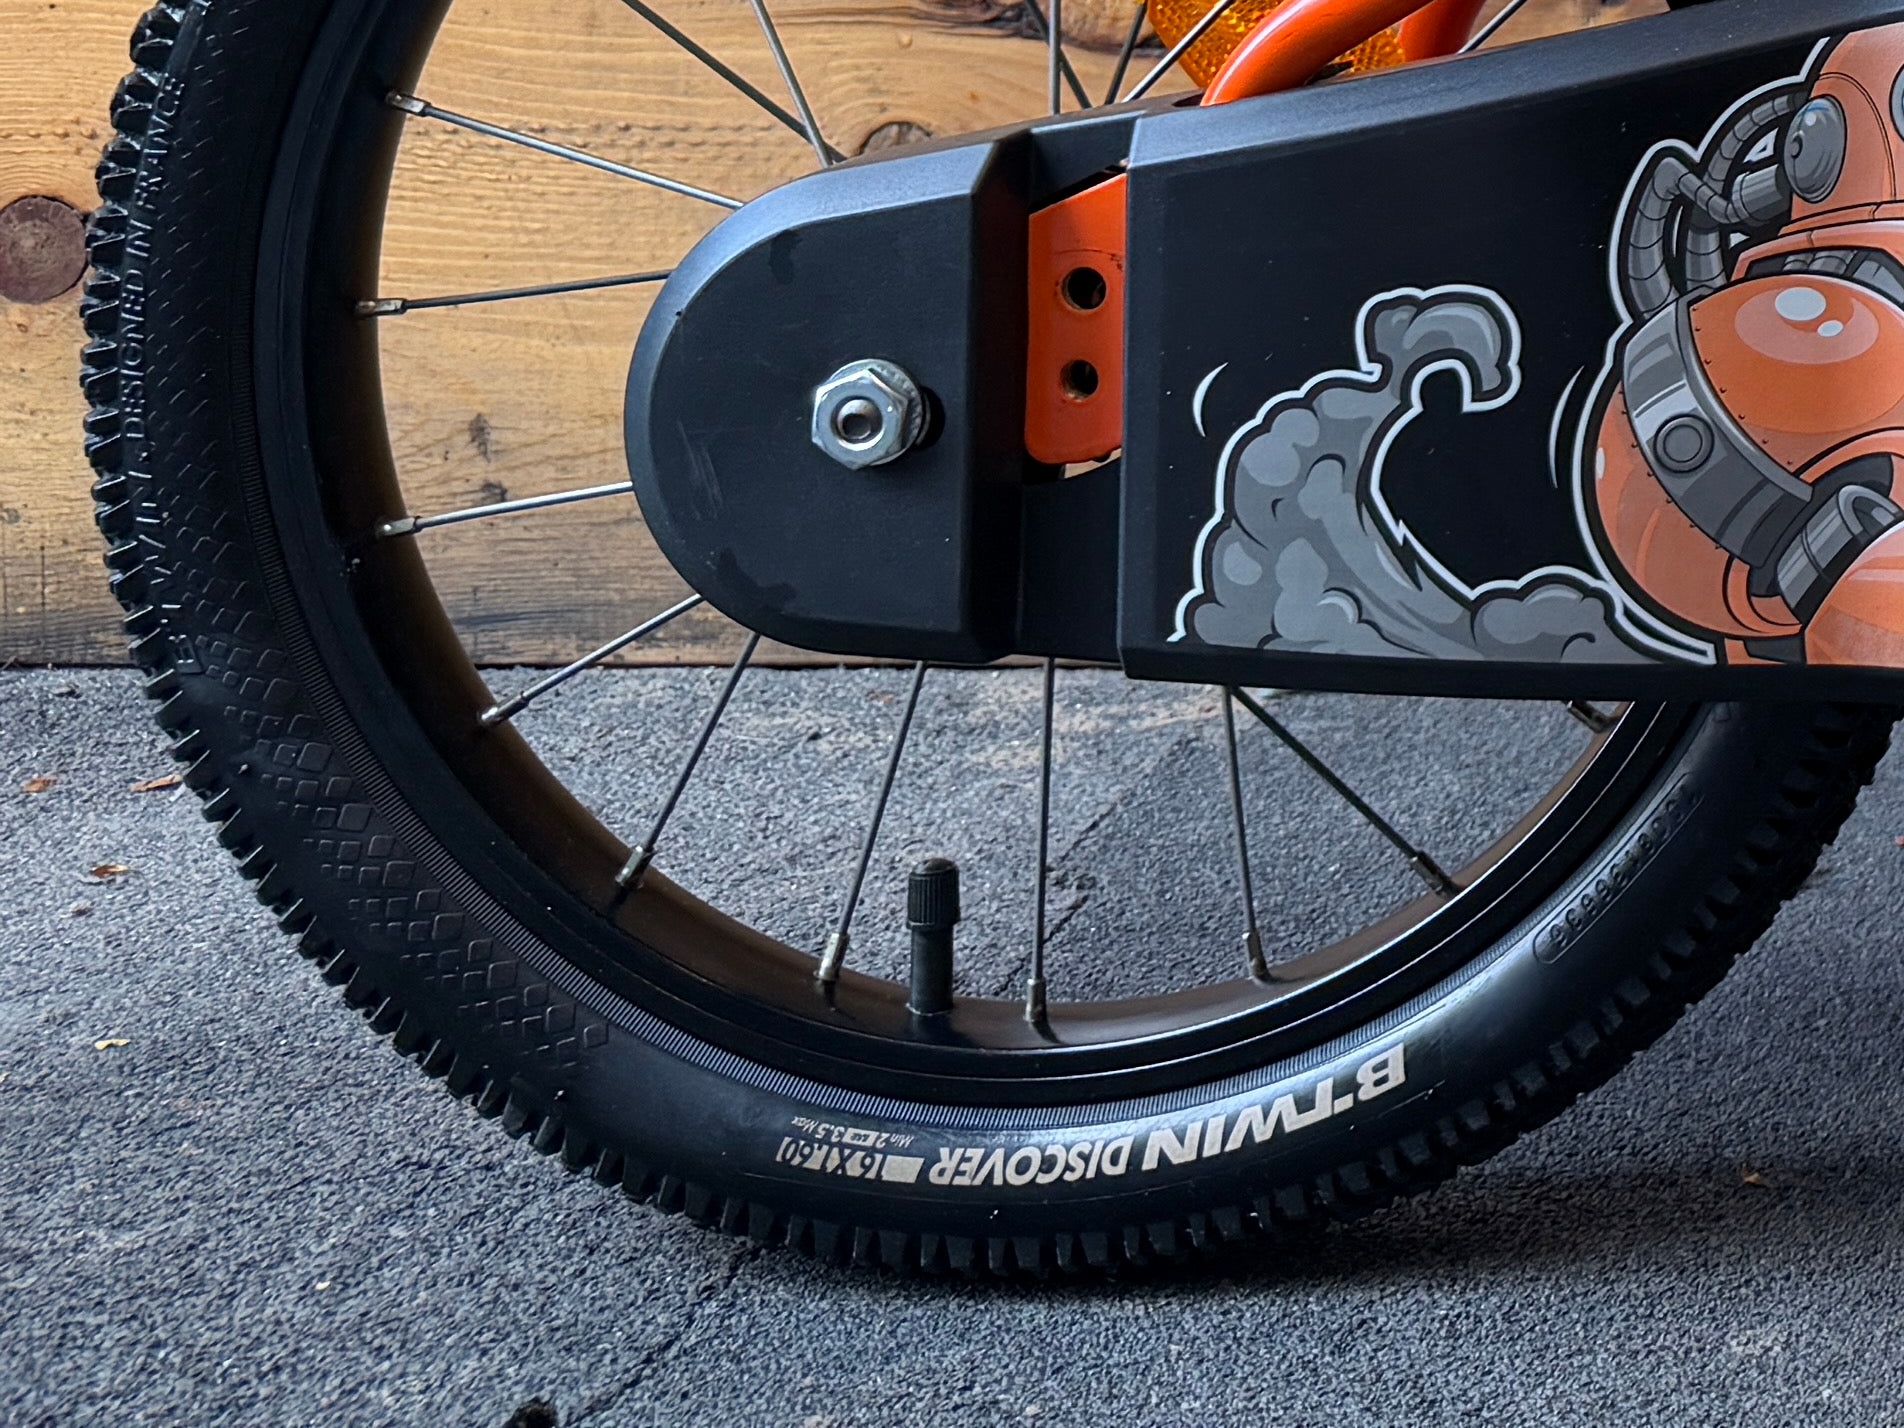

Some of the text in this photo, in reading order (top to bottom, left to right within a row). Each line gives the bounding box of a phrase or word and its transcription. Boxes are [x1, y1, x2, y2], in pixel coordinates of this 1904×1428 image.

[133, 72, 186, 209] FRANCE
[125, 218, 152, 256] IN
[119, 268, 150, 440] DESIGNED
[791, 1116, 819, 1135] Max
[815, 1124, 846, 1143] 3.5
[875, 1132, 891, 1148] 2
[890, 1133, 914, 1149] Min
[929, 1136, 1133, 1187] DISCOVER
